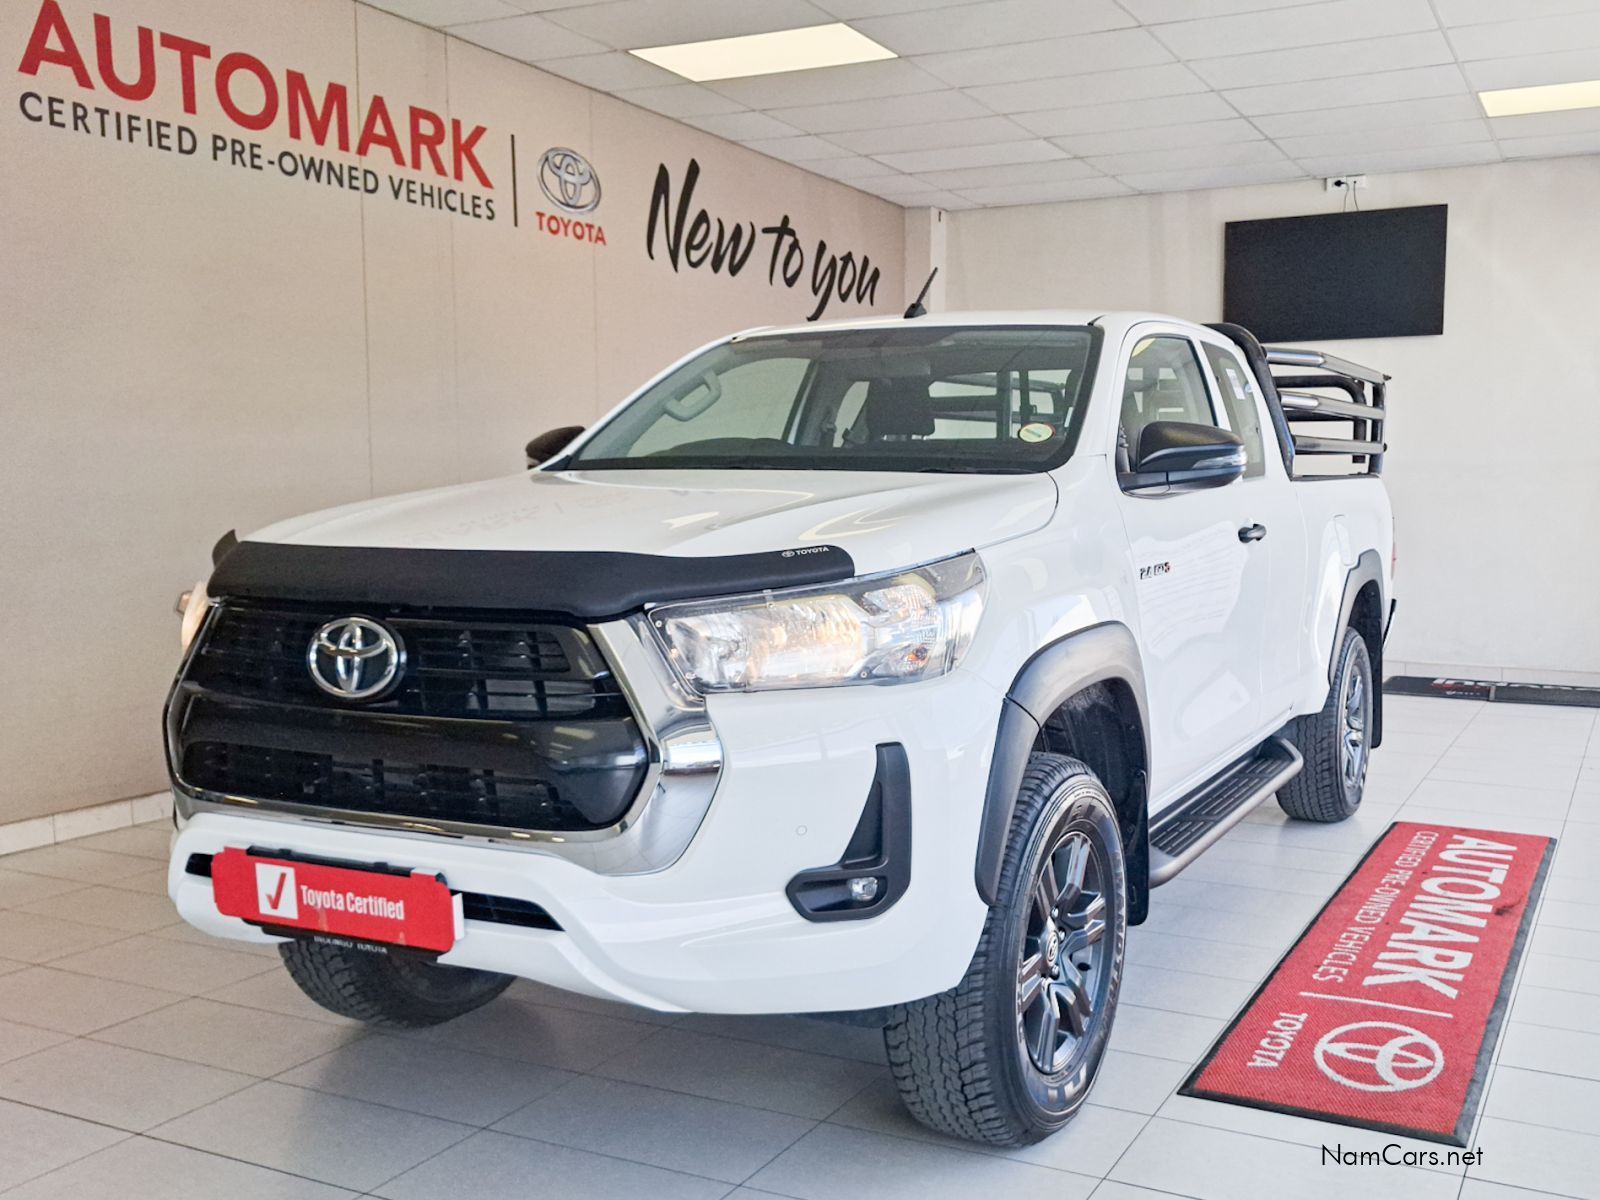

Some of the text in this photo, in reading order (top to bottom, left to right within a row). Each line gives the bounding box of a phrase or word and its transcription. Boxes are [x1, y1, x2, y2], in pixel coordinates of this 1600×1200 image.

[18, 0, 494, 190] AUTOMARK
[19, 91, 496, 222] CERTIFIED PRE-OWNED VEHICLES
[535, 211, 607, 246] TOYOTA
[647, 157, 881, 322] New to you
[795, 546, 830, 556] TOYOTA
[300, 884, 405, 920] Toyota Certified
[1312, 830, 1440, 983] CERTIFIED PRE-OWNED VEHICLES
[1362, 833, 1519, 1000] AUTOMARK
[1246, 1012, 1309, 1068] TOYOTA
